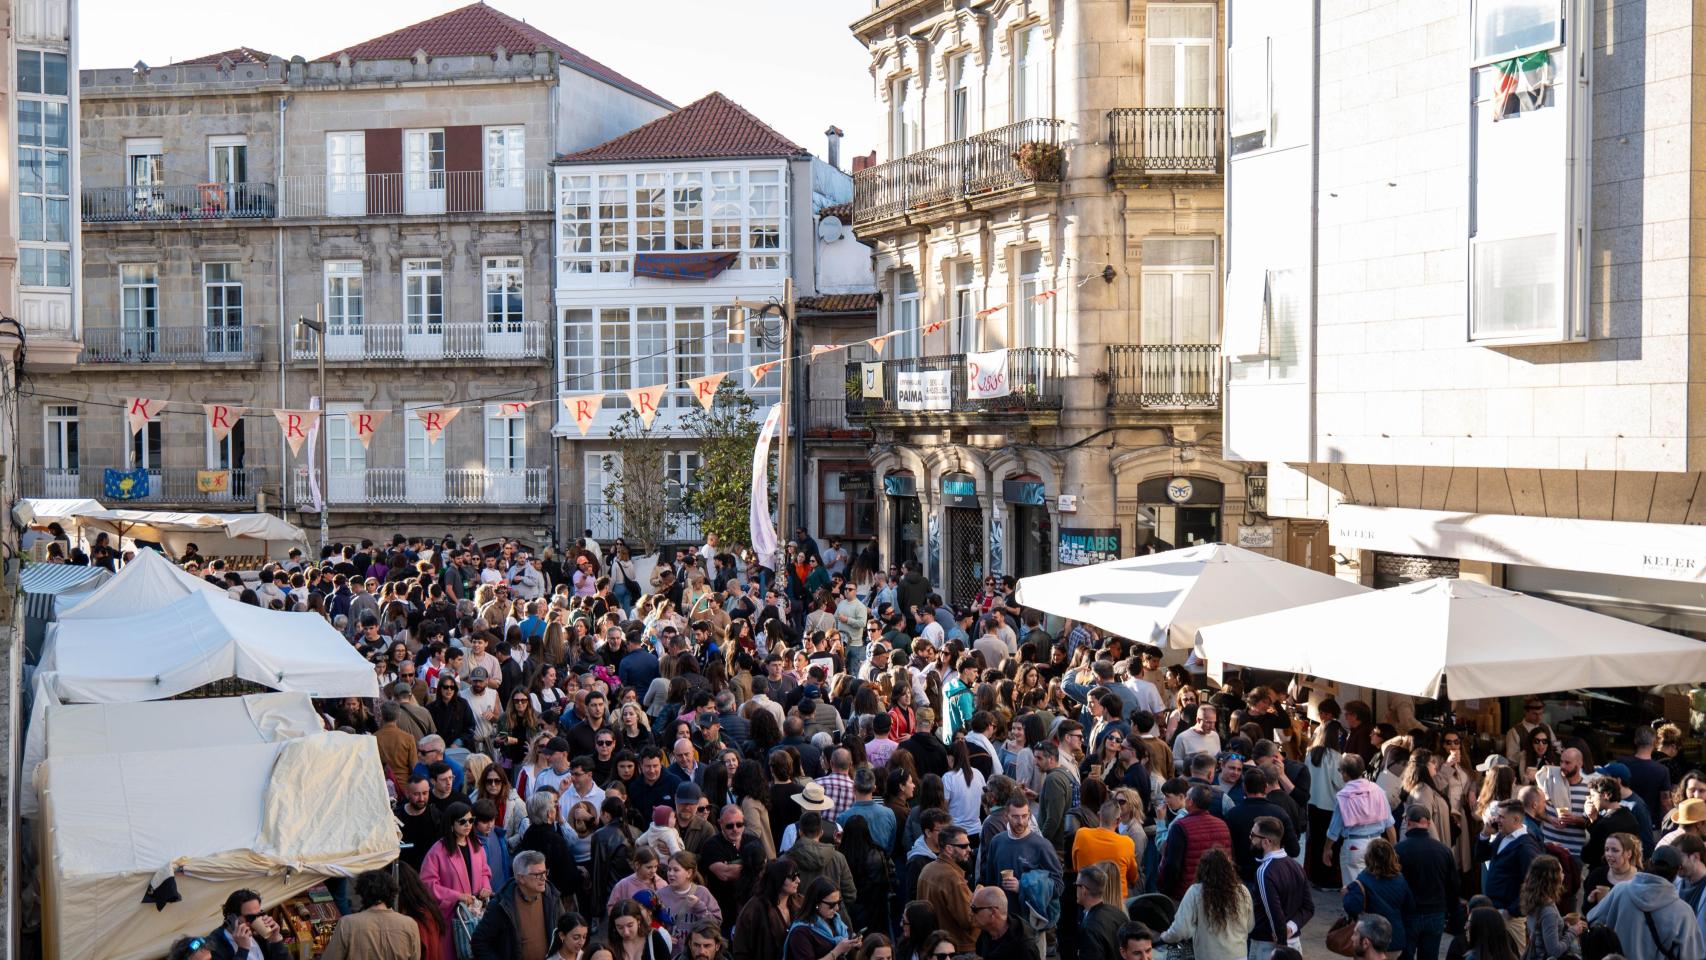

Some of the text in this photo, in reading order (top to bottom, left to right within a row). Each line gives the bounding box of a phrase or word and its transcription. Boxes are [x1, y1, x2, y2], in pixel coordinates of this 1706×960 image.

[699, 380, 713, 399] R
[899, 390, 923, 403] PAIMA
[577, 399, 592, 421] R
[638, 392, 655, 414] R
[212, 405, 230, 428] R
[287, 414, 305, 438] R
[359, 414, 374, 435] R
[426, 412, 442, 431] R
[943, 479, 975, 496] CANNABIS
[1643, 555, 1696, 569] KELER
